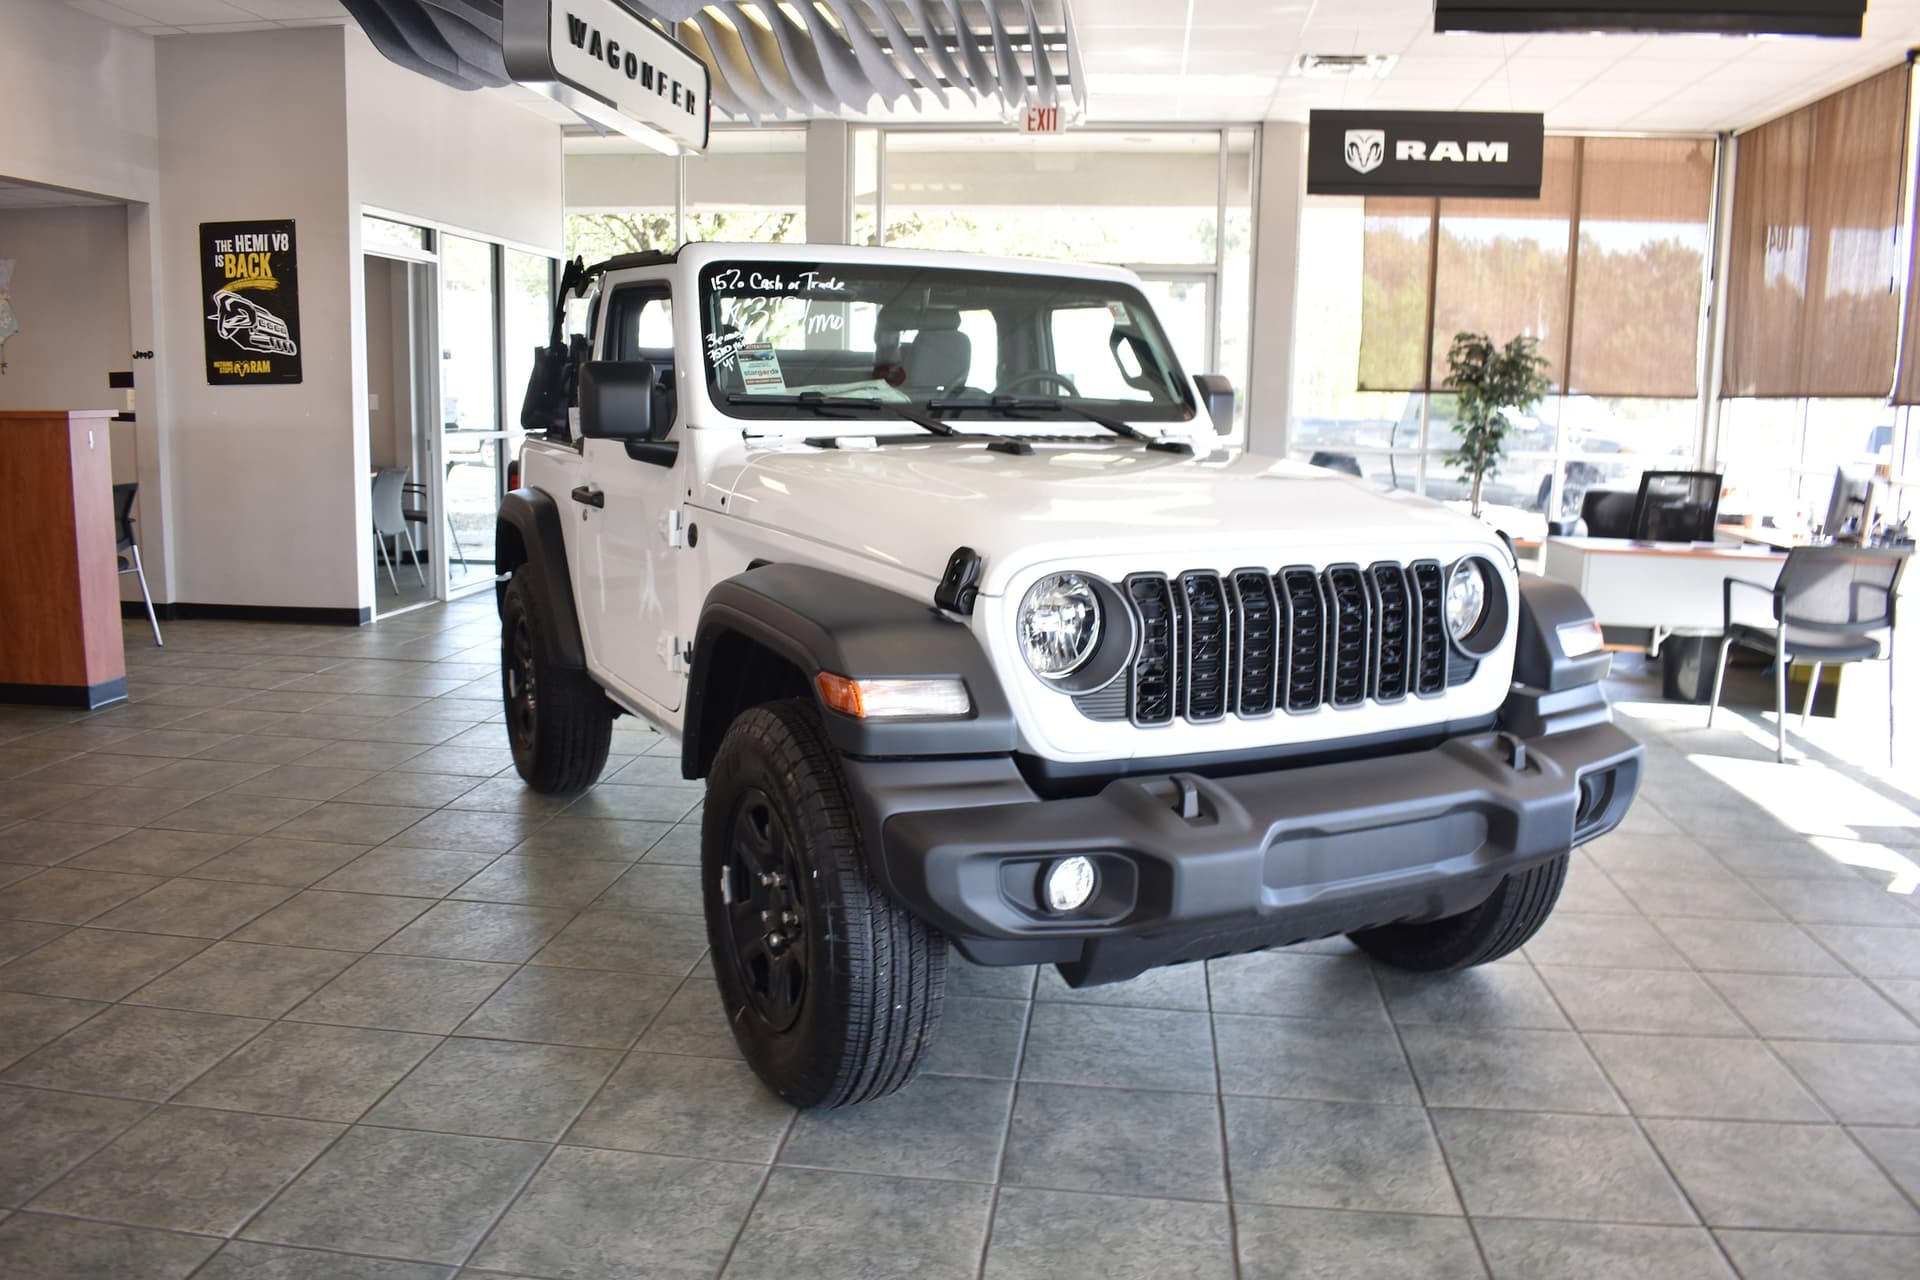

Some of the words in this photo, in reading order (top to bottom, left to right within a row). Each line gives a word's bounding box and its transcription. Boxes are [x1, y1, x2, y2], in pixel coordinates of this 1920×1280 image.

[1027, 107, 1057, 131] EXIT
[1395, 139, 1509, 163] RAM
[215, 239, 233, 253] THE
[234, 233, 269, 252] HEMI
[271, 232, 289, 252] V8
[214, 254, 224, 268] IS
[224, 252, 273, 279] BACK
[710, 268, 745, 291] 15%
[749, 272, 783, 291] Cash
[798, 271, 846, 291] Trade
[250, 360, 271, 373] RAM
